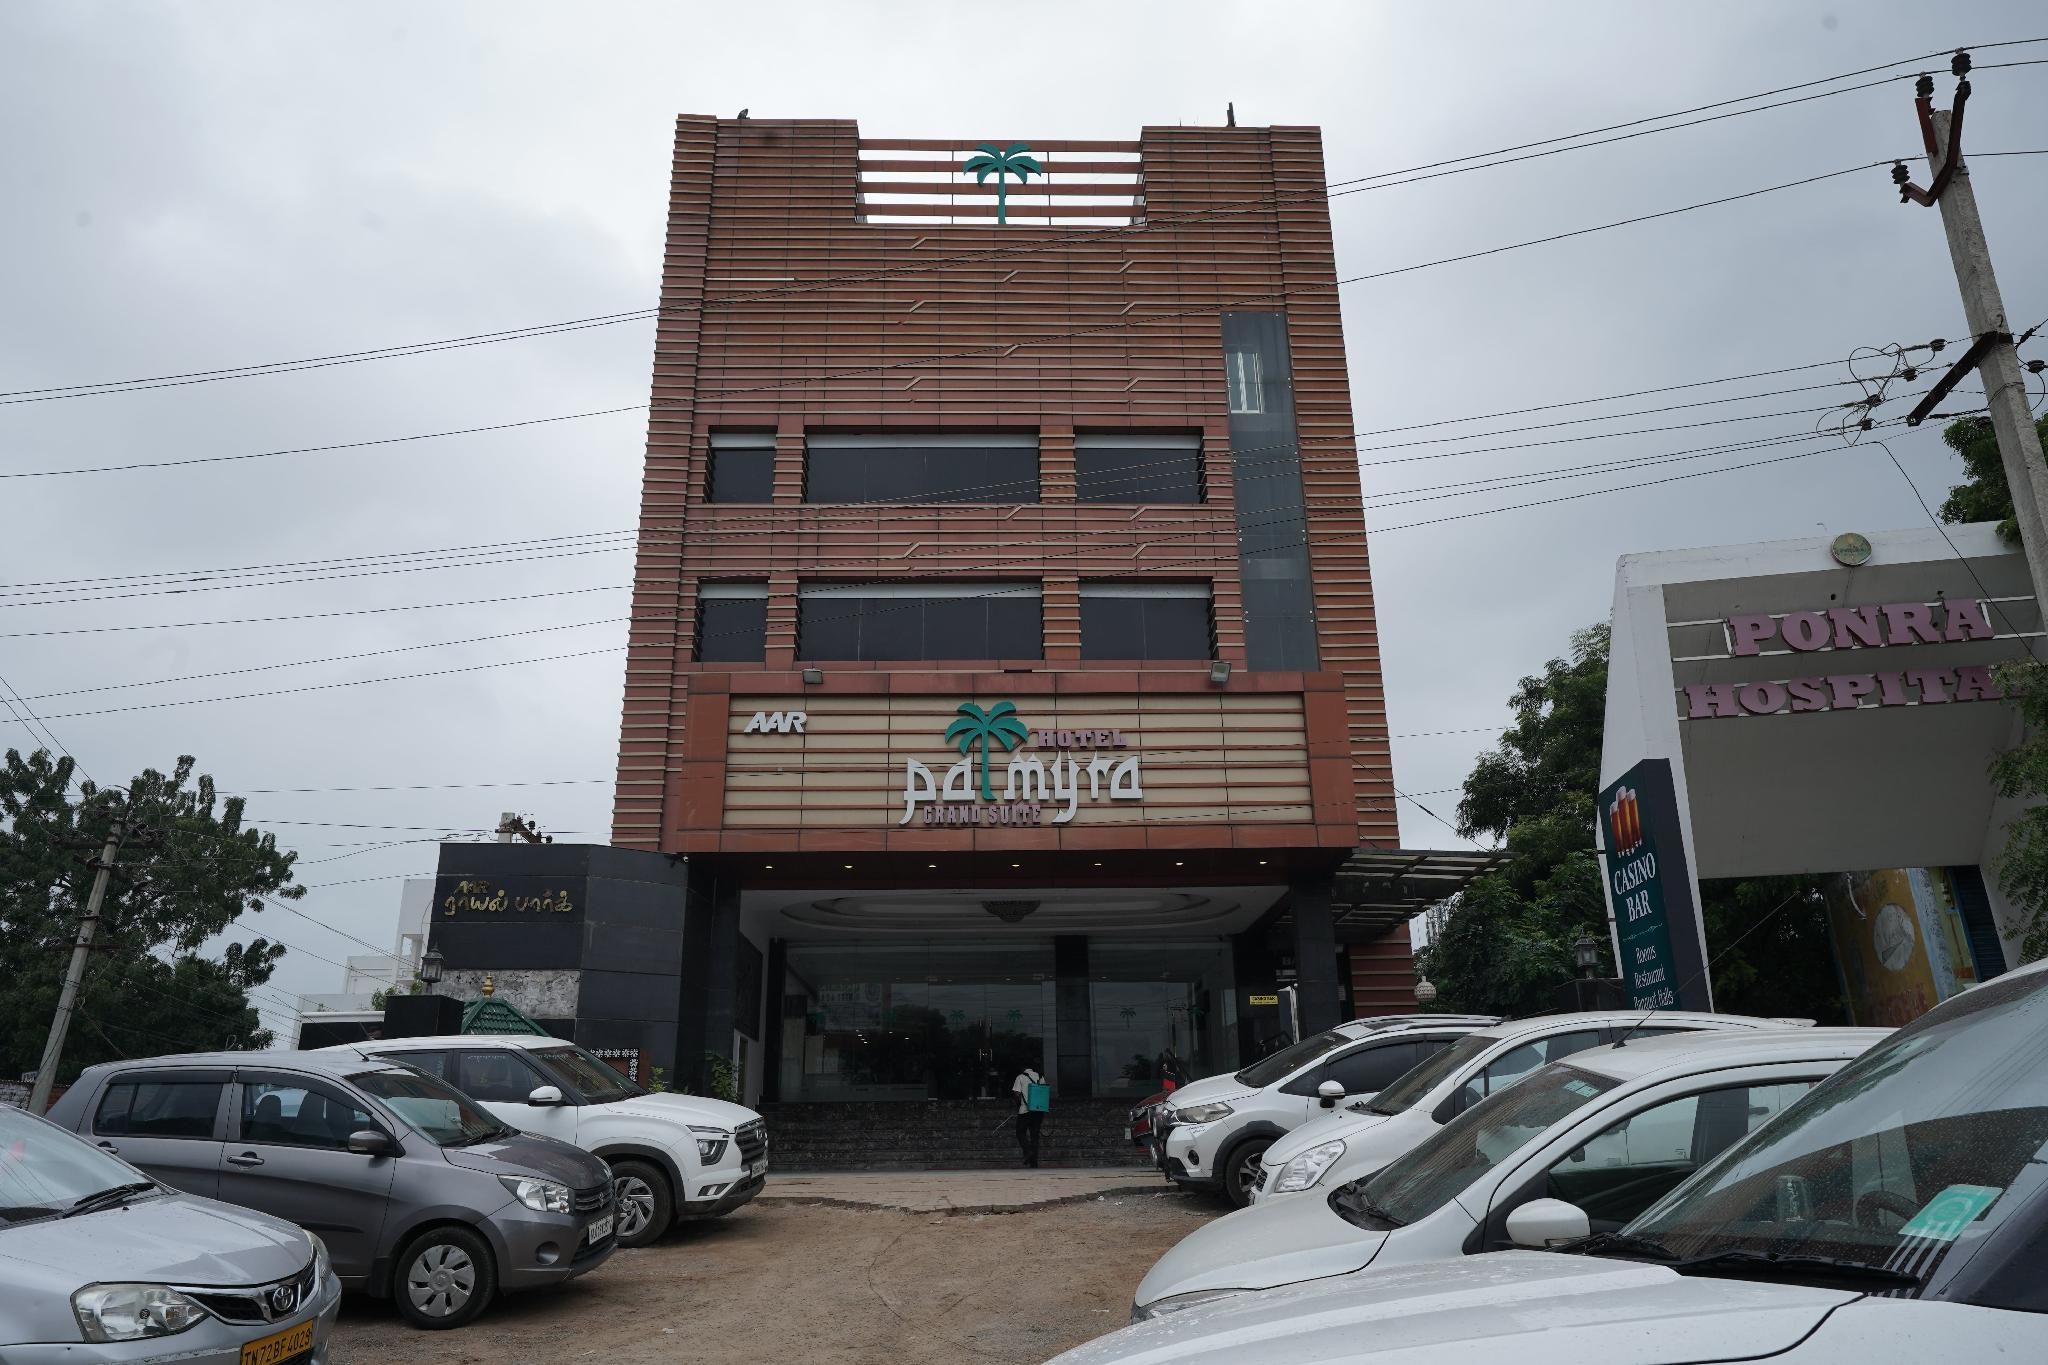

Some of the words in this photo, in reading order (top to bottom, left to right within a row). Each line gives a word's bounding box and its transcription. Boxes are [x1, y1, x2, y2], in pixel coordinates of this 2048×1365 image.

[1727, 599, 1995, 656] PONRA
[1683, 664, 2032, 718] HOSPITA
[743, 711, 808, 733] AAR
[1037, 728, 1128, 748] HOTEL
[923, 804, 982, 824] GRAND
[988, 804, 1042, 825] SUITE
[1614, 852, 1657, 895] CASINO
[1625, 889, 1653, 923] BAR
